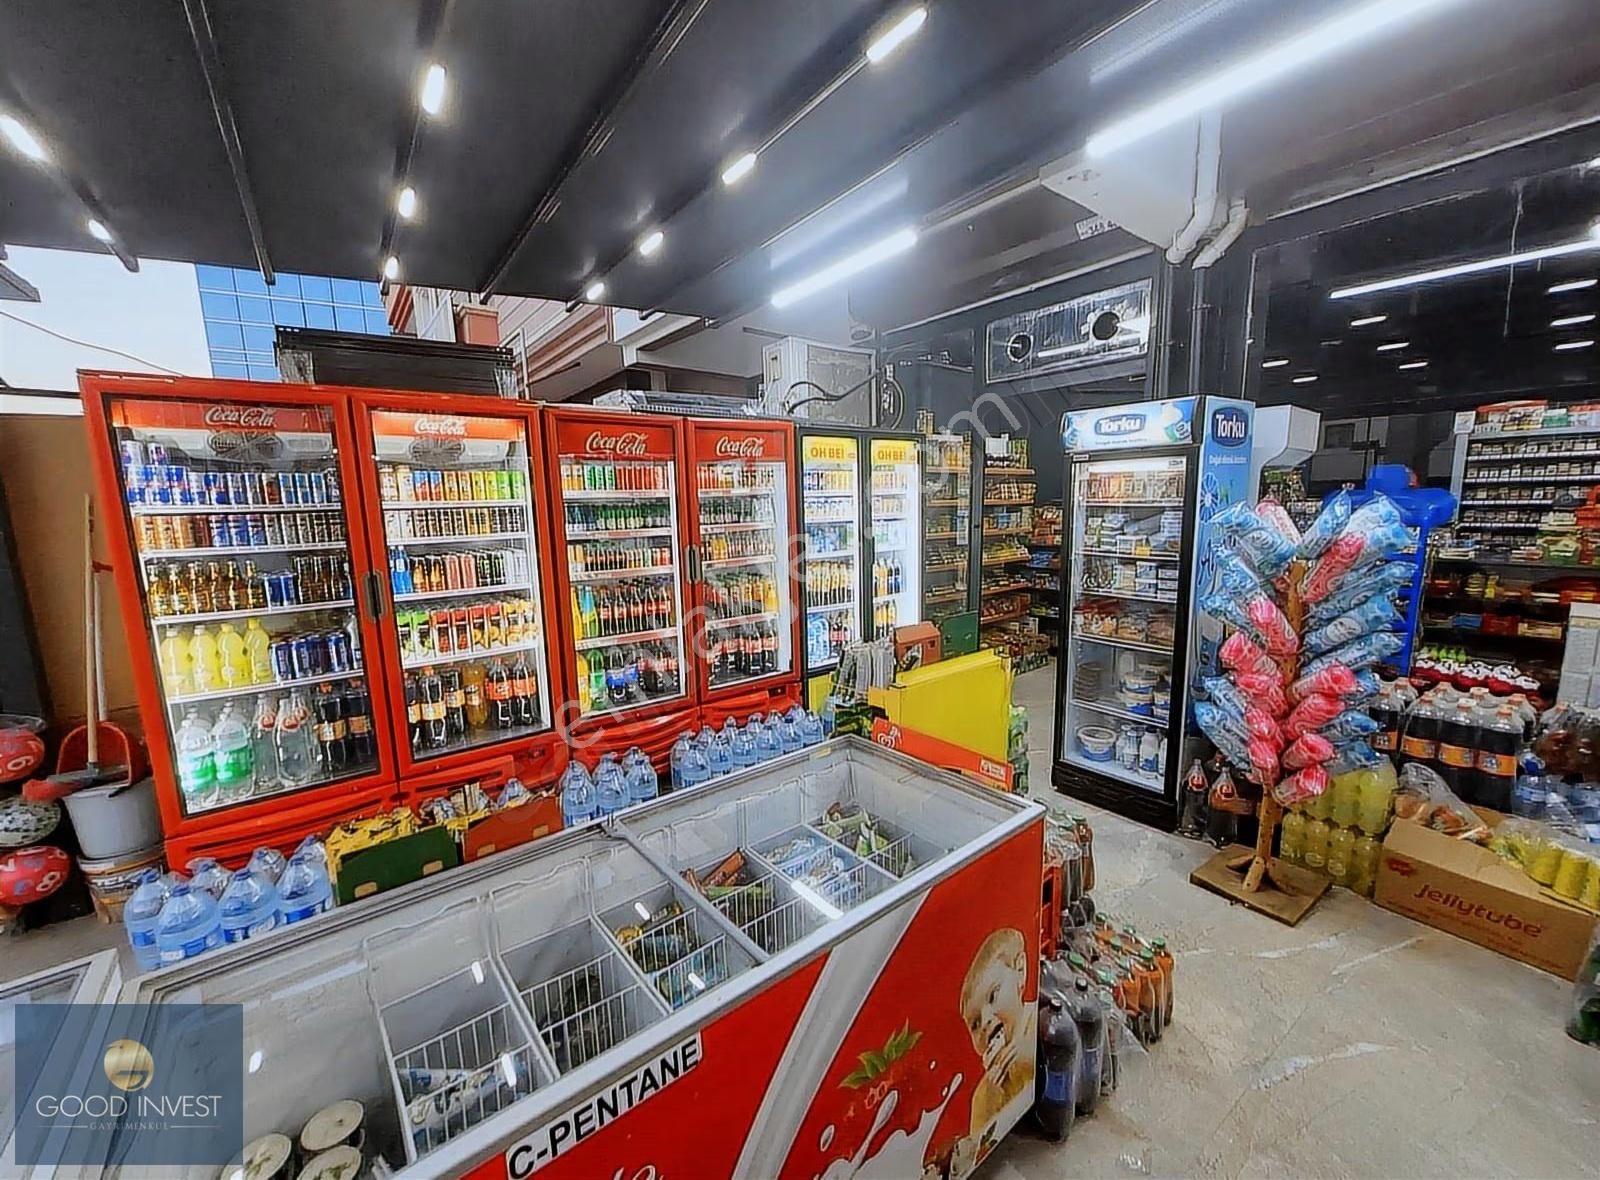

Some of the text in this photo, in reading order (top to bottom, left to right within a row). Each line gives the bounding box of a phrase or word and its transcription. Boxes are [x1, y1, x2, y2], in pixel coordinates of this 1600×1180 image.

[1099, 415, 1141, 433] Torku
[1215, 413, 1246, 438] Torku
[508, 1037, 700, 1179] C-PENTANE
